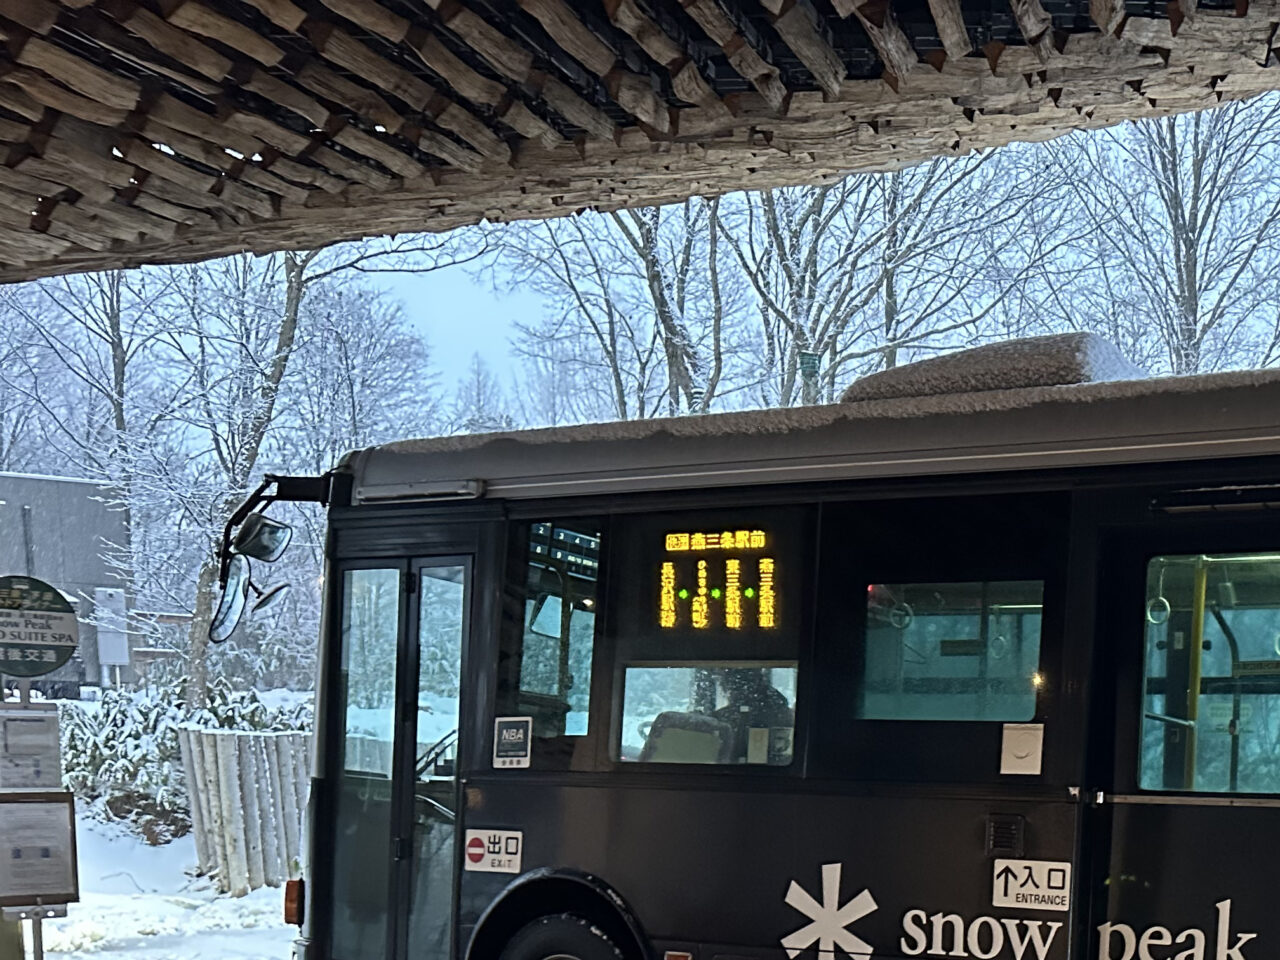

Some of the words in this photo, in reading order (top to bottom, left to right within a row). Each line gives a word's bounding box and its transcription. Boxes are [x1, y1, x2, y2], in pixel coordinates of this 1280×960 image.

[24, 619, 52, 630] Peak
[9, 630, 48, 641] SUITE
[50, 633, 74, 643] SPA
[502, 728, 524, 741] NBA
[487, 834, 519, 855] 出口
[491, 859, 512, 868] EXIT
[1019, 865, 1066, 890] 入口
[1015, 893, 1067, 906] ENTRANCE
